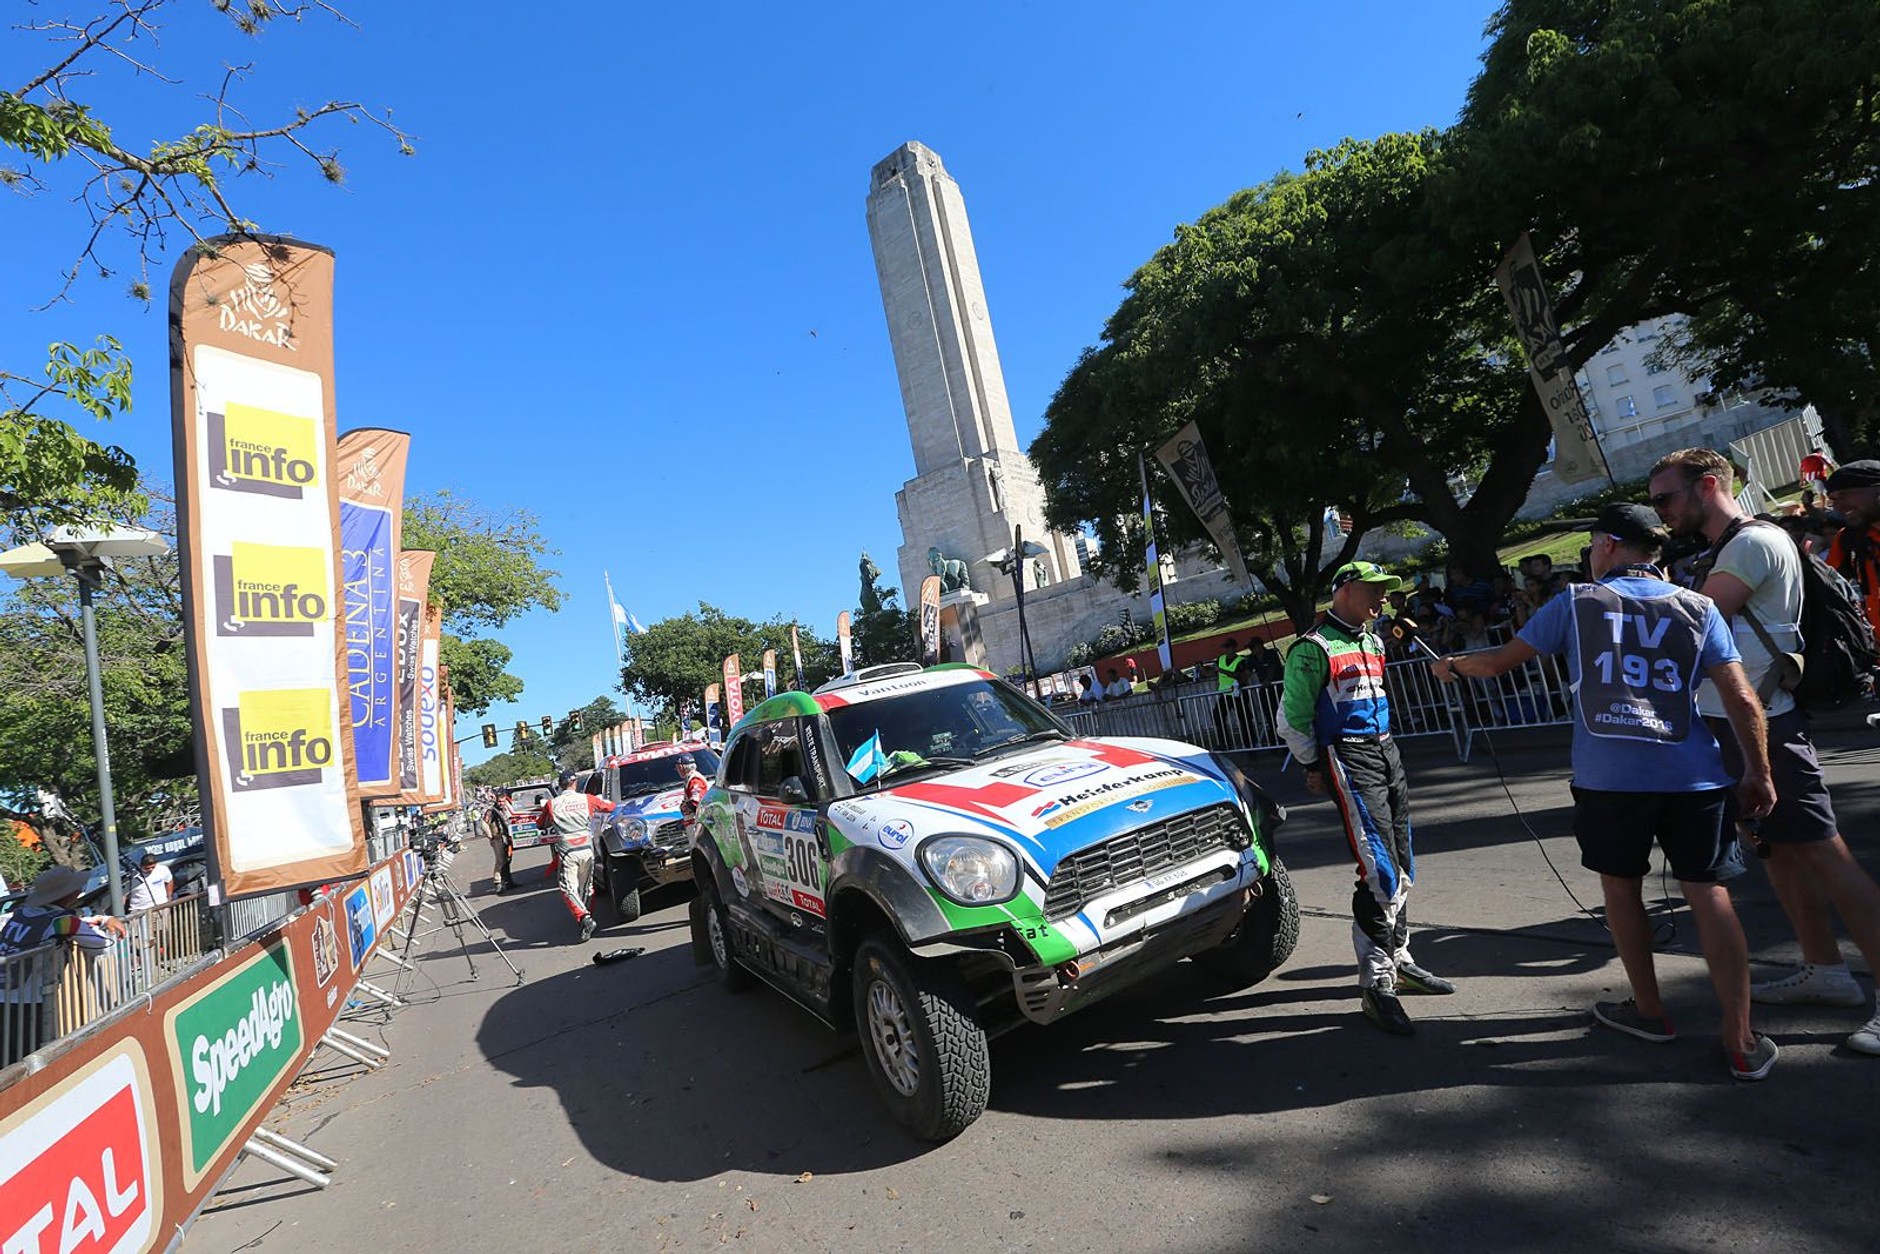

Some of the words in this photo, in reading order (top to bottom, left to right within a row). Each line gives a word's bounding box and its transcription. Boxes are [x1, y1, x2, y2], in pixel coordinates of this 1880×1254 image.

[219, 304, 298, 352] DAKAR
[230, 438, 272, 453] france
[231, 447, 314, 484] info
[342, 549, 368, 567] 3
[237, 579, 280, 592] france
[238, 583, 326, 620] info
[373, 547, 387, 727] ARGENTINA
[408, 619, 418, 654] Watches
[1603, 612, 1672, 649] TV
[343, 578, 371, 728] CADENA
[407, 655, 416, 680] Swiss
[1593, 651, 1683, 693] 193
[405, 709, 414, 745] Watches
[1594, 712, 1673, 731] #Dakar2016
[1609, 702, 1657, 718] @Dakar
[244, 729, 288, 743] france
[246, 729, 332, 772] info
[406, 746, 416, 772] Swiss
[1058, 768, 1184, 807] Heisterkamp
[760, 809, 783, 827] TOTAL
[882, 824, 910, 845] eurol
[784, 835, 820, 892] 306
[798, 894, 823, 912] TOTAL
[4, 921, 32, 943] TV
[192, 976, 293, 1116] SpeedAgro
